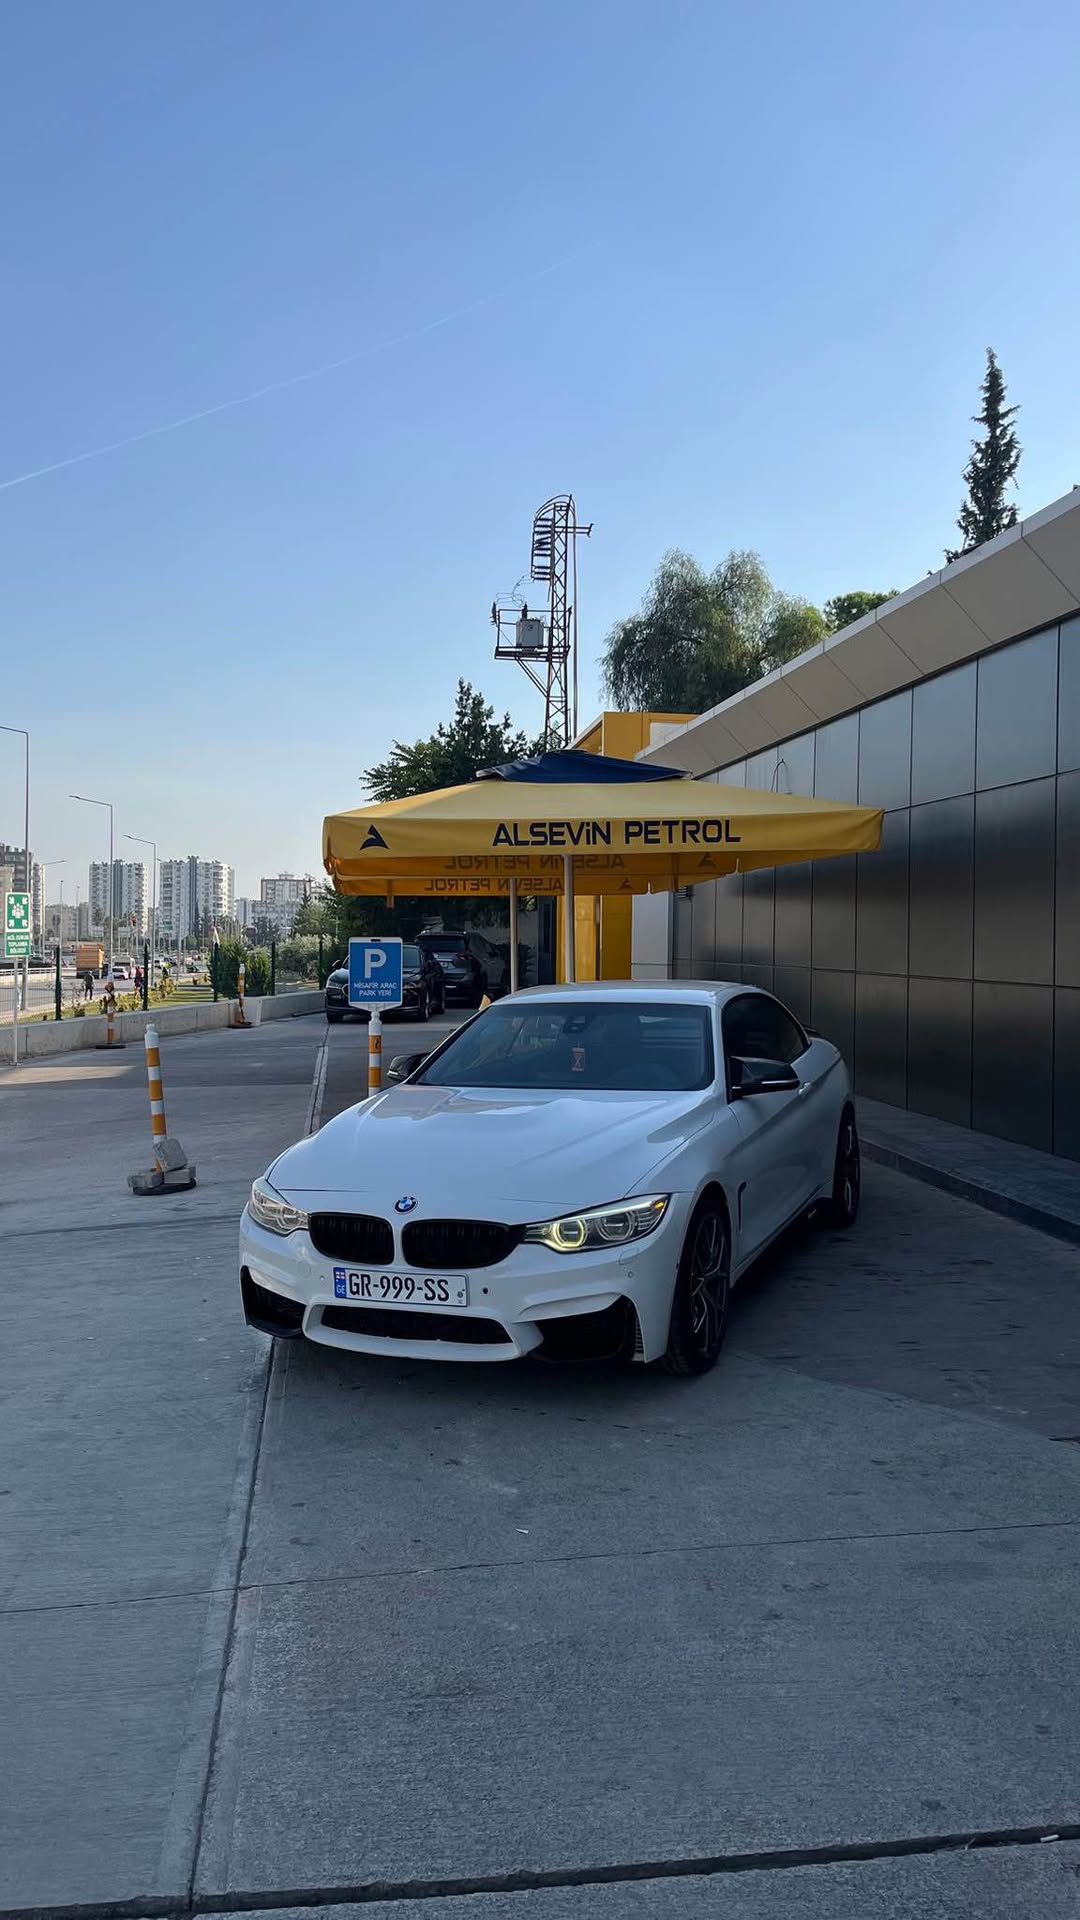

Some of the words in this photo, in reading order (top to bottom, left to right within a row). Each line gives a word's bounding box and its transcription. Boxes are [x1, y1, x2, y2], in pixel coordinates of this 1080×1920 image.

[624, 819, 741, 844] PETROL
[364, 948, 387, 978] P
[349, 1273, 449, 1301] GR-999-SS
